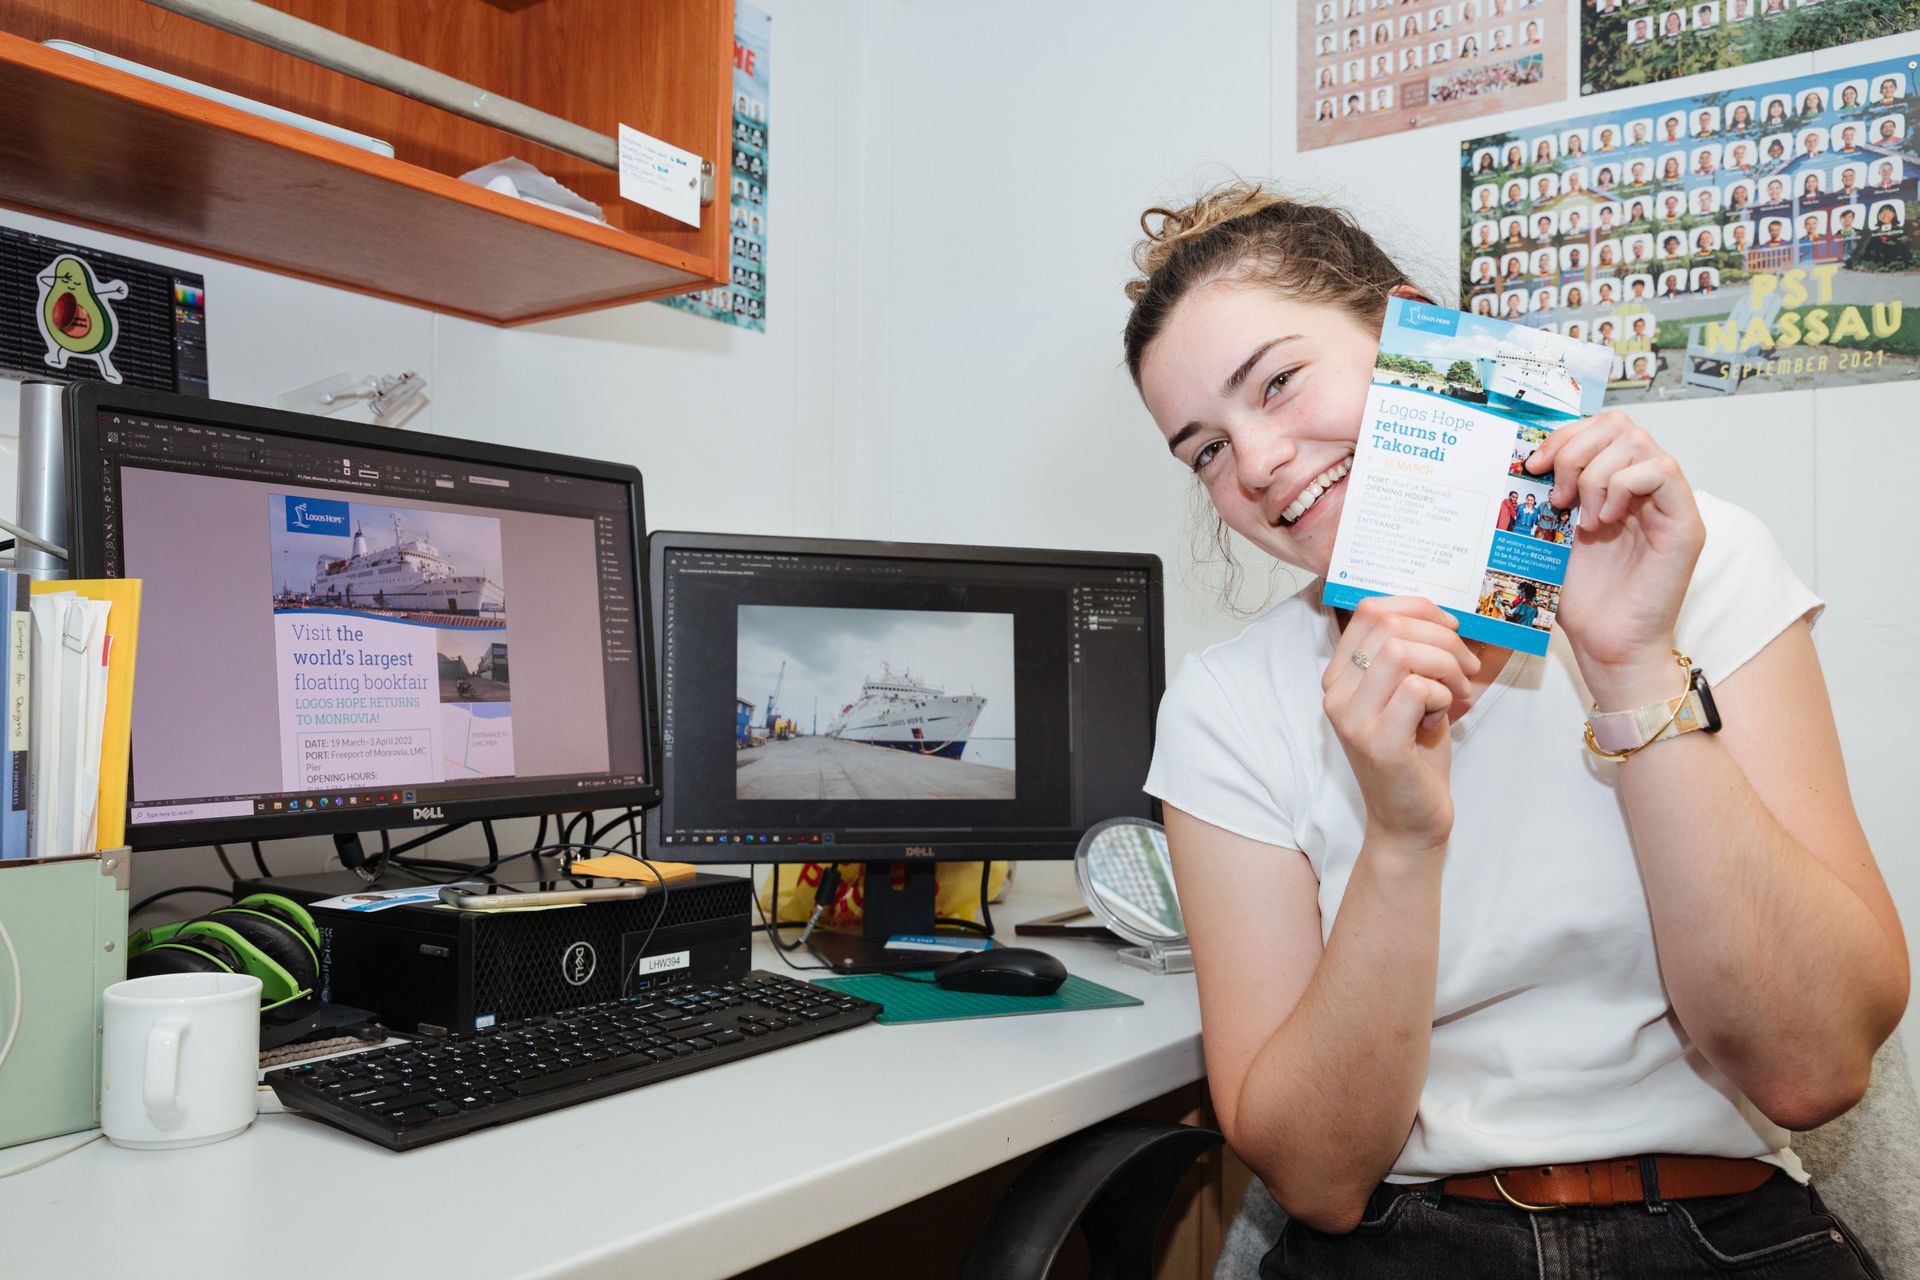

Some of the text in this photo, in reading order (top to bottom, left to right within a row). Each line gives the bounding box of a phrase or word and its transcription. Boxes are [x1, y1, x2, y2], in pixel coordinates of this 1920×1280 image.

[1751, 265, 1839, 310] PST
[1704, 300, 1902, 353] NASSAU
[1720, 350, 1884, 380] SEPTEMBER 2021
[1379, 399, 1474, 431] Logos Hope
[1375, 419, 1457, 445] returns to
[1372, 435, 1446, 462] Takoradi
[1395, 460, 1435, 476] MARCH
[1365, 484, 1403, 496] OPENING
[1530, 552, 1562, 565] REQUIRED
[292, 623, 364, 642] Visit the
[294, 649, 414, 671] world's largest
[16, 672, 26, 687] for
[295, 673, 429, 694] floating bookfair
[296, 696, 420, 710] LOGOS HOPE RETURNS
[296, 713, 380, 725] TO MONROVIA!
[305, 740, 329, 749] DATE:
[331, 739, 341, 748] 19
[376, 737, 394, 748] April
[395, 736, 413, 746] 2022
[306, 747, 427, 762] PORT: Freeport of Monrovia, LMC
[306, 763, 321, 772] Pier
[307, 772, 378, 784] OPENING HOURS:
[147, 811, 158, 819] Type
[413, 806, 444, 820] DELL
[906, 846, 935, 858] DELL
[575, 947, 585, 982] DELL
[649, 956, 681, 971] LHW394
